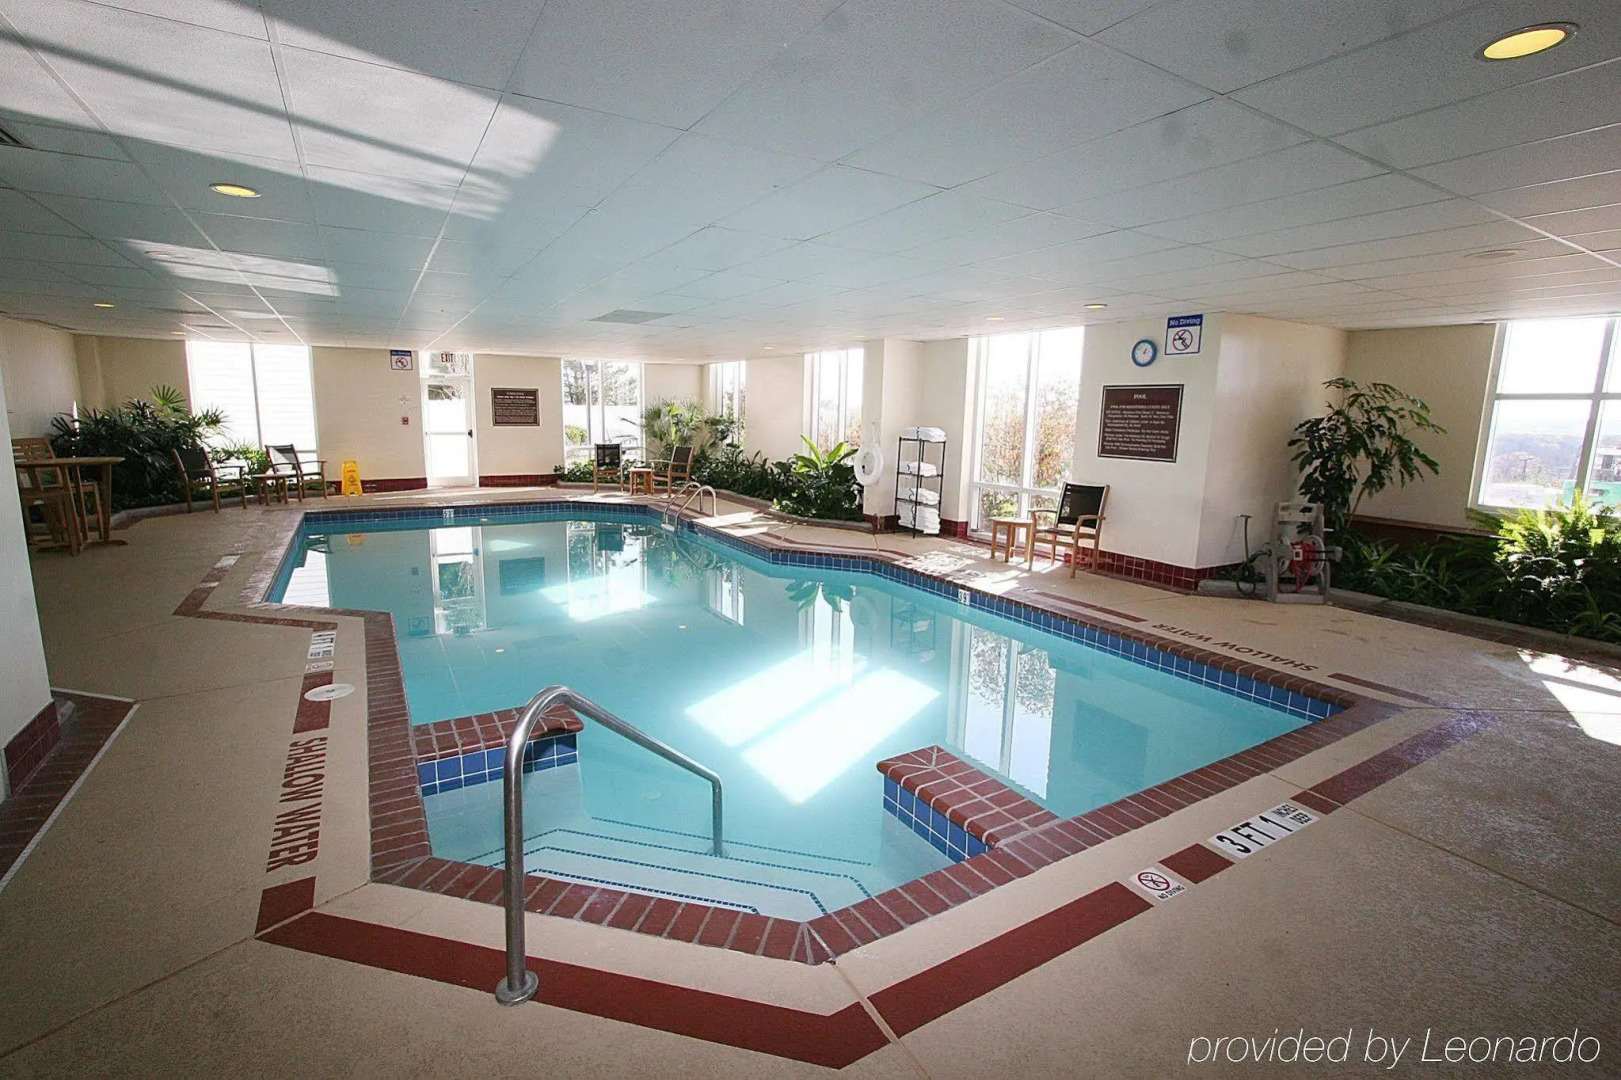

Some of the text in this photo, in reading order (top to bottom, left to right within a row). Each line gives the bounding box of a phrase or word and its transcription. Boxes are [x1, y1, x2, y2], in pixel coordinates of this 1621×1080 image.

[1180, 318, 1200, 326] Diving
[441, 353, 453, 362] EXIT
[1152, 623, 1318, 672] SHALLOW WATER
[266, 736, 328, 873] SHALLOW WATER
[1157, 892, 1169, 900] NO
